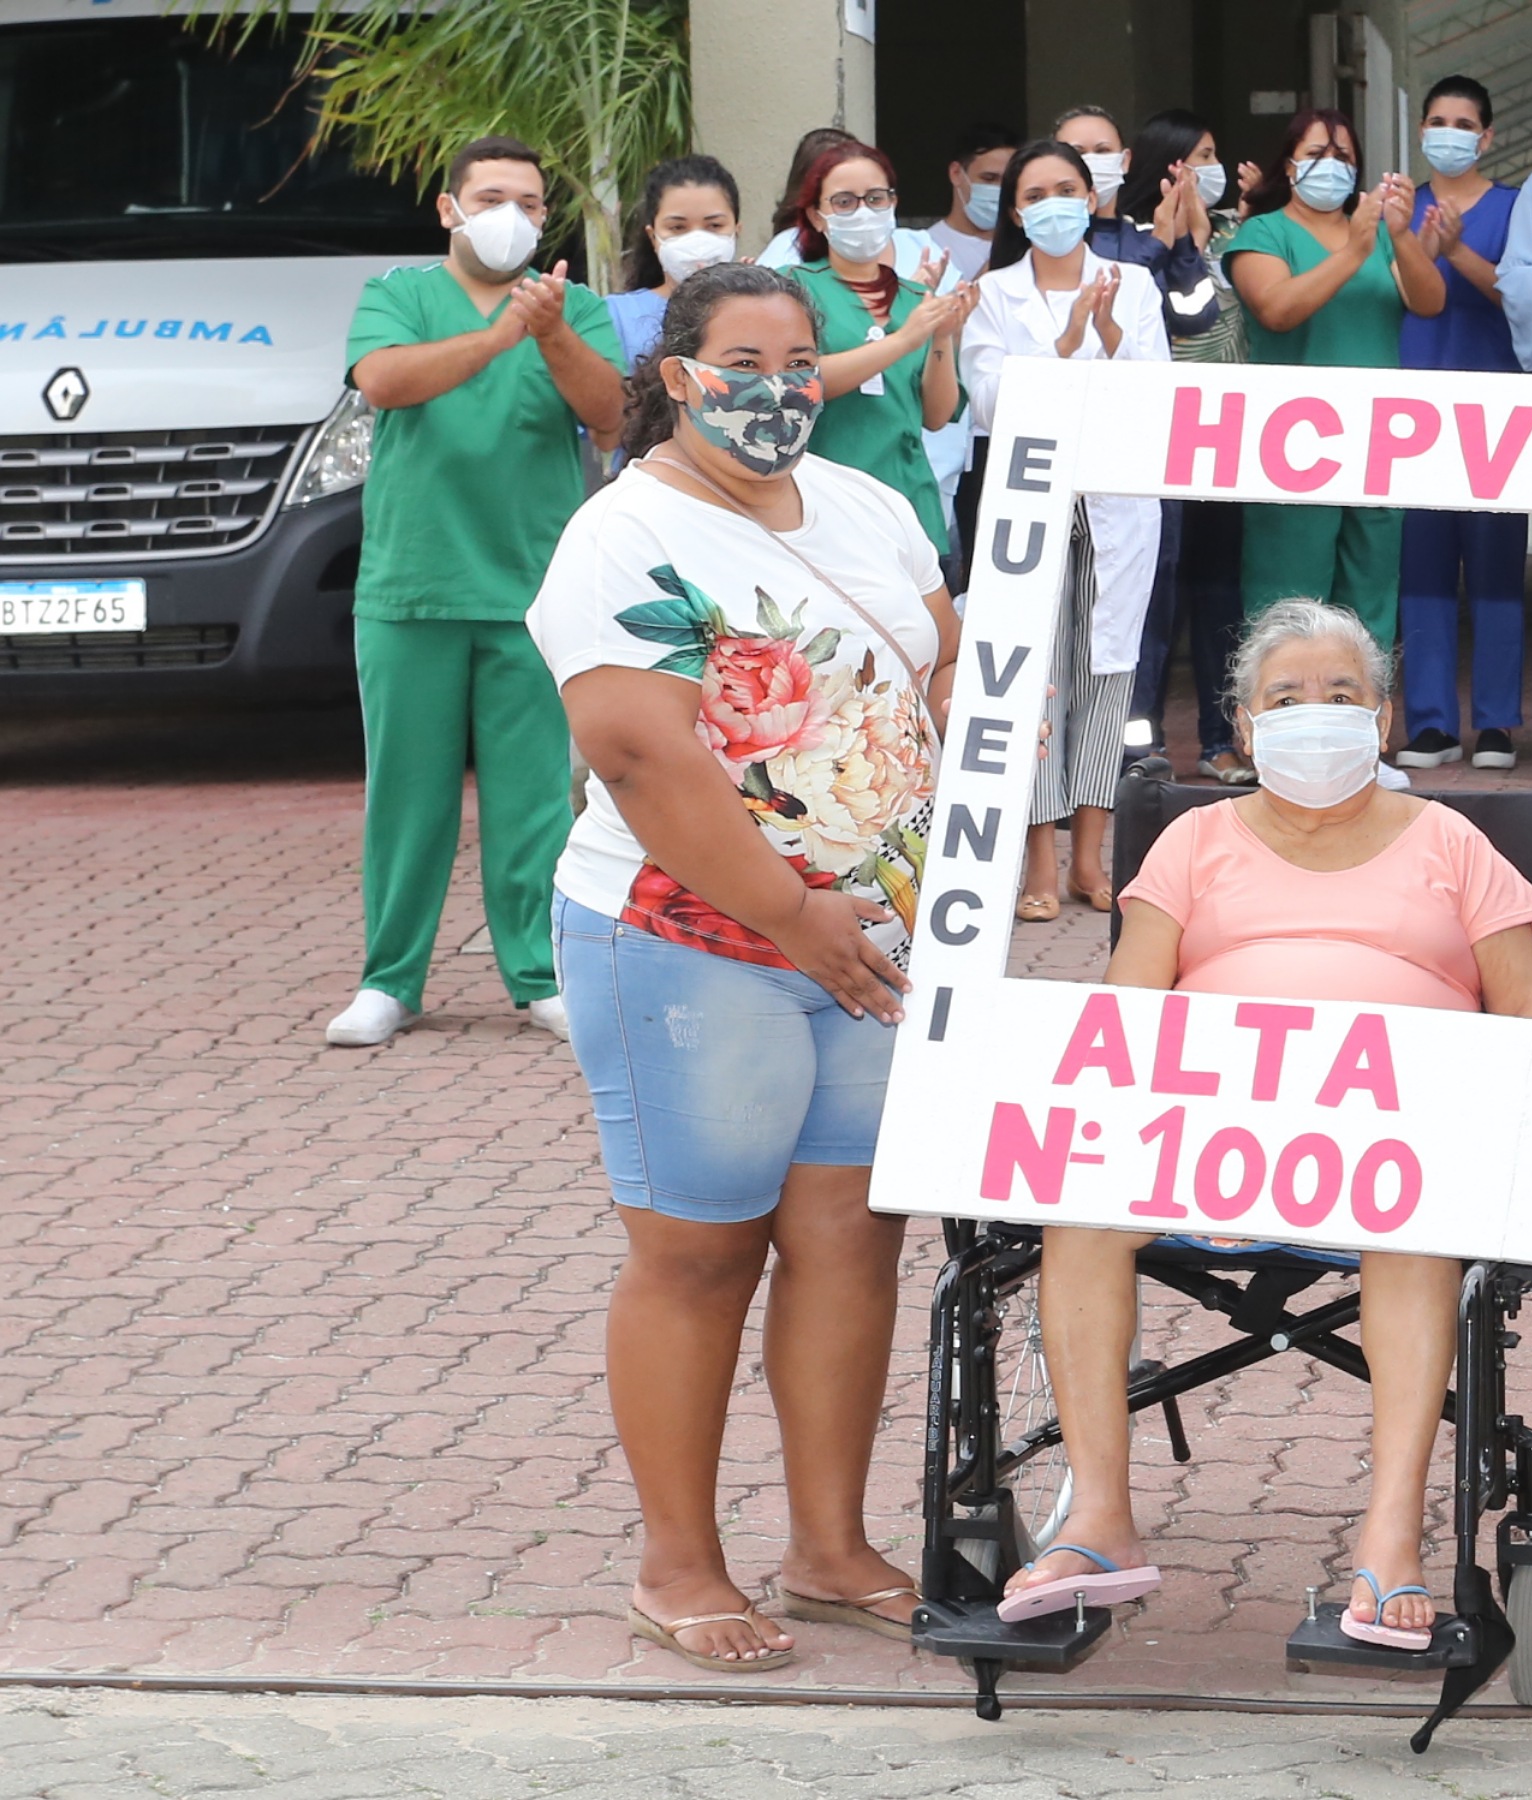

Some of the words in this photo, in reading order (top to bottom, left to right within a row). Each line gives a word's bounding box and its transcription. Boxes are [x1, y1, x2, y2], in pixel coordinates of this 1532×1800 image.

[991, 436, 1057, 575] EU
[2, 597, 125, 625] BTZ2F65
[927, 640, 1032, 1042] VENCI
[1052, 992, 1400, 1112] ALTA
[1128, 1105, 1423, 1234] 1000
